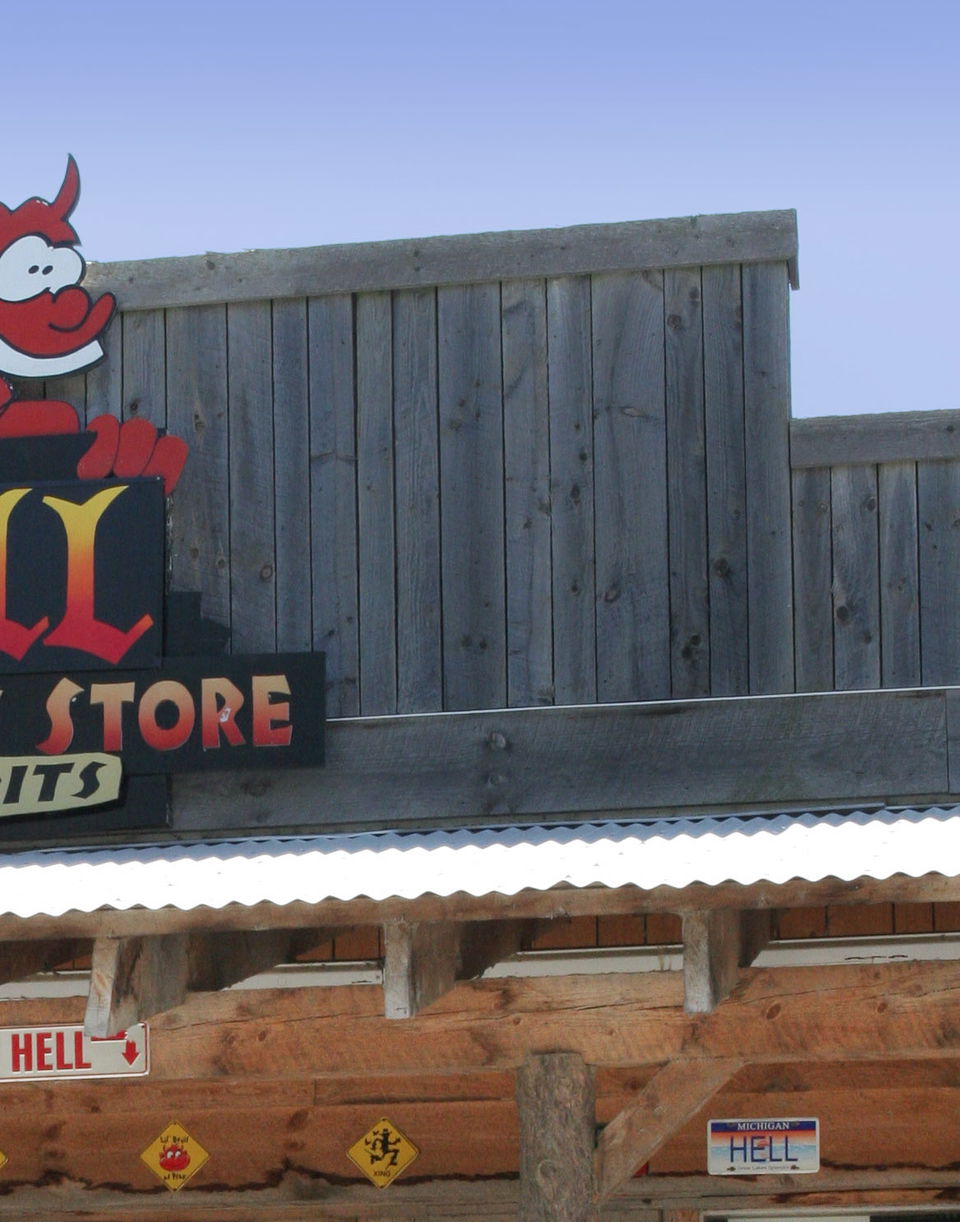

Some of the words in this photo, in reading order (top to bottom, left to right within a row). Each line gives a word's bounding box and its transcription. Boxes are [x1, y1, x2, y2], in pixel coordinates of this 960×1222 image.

[36, 673, 294, 758] STORE
[11, 1031, 92, 1073] HELL
[737, 1121, 790, 1131] MICHIGAN
[730, 1135, 799, 1163] HELL
[373, 1170, 391, 1178] XING
